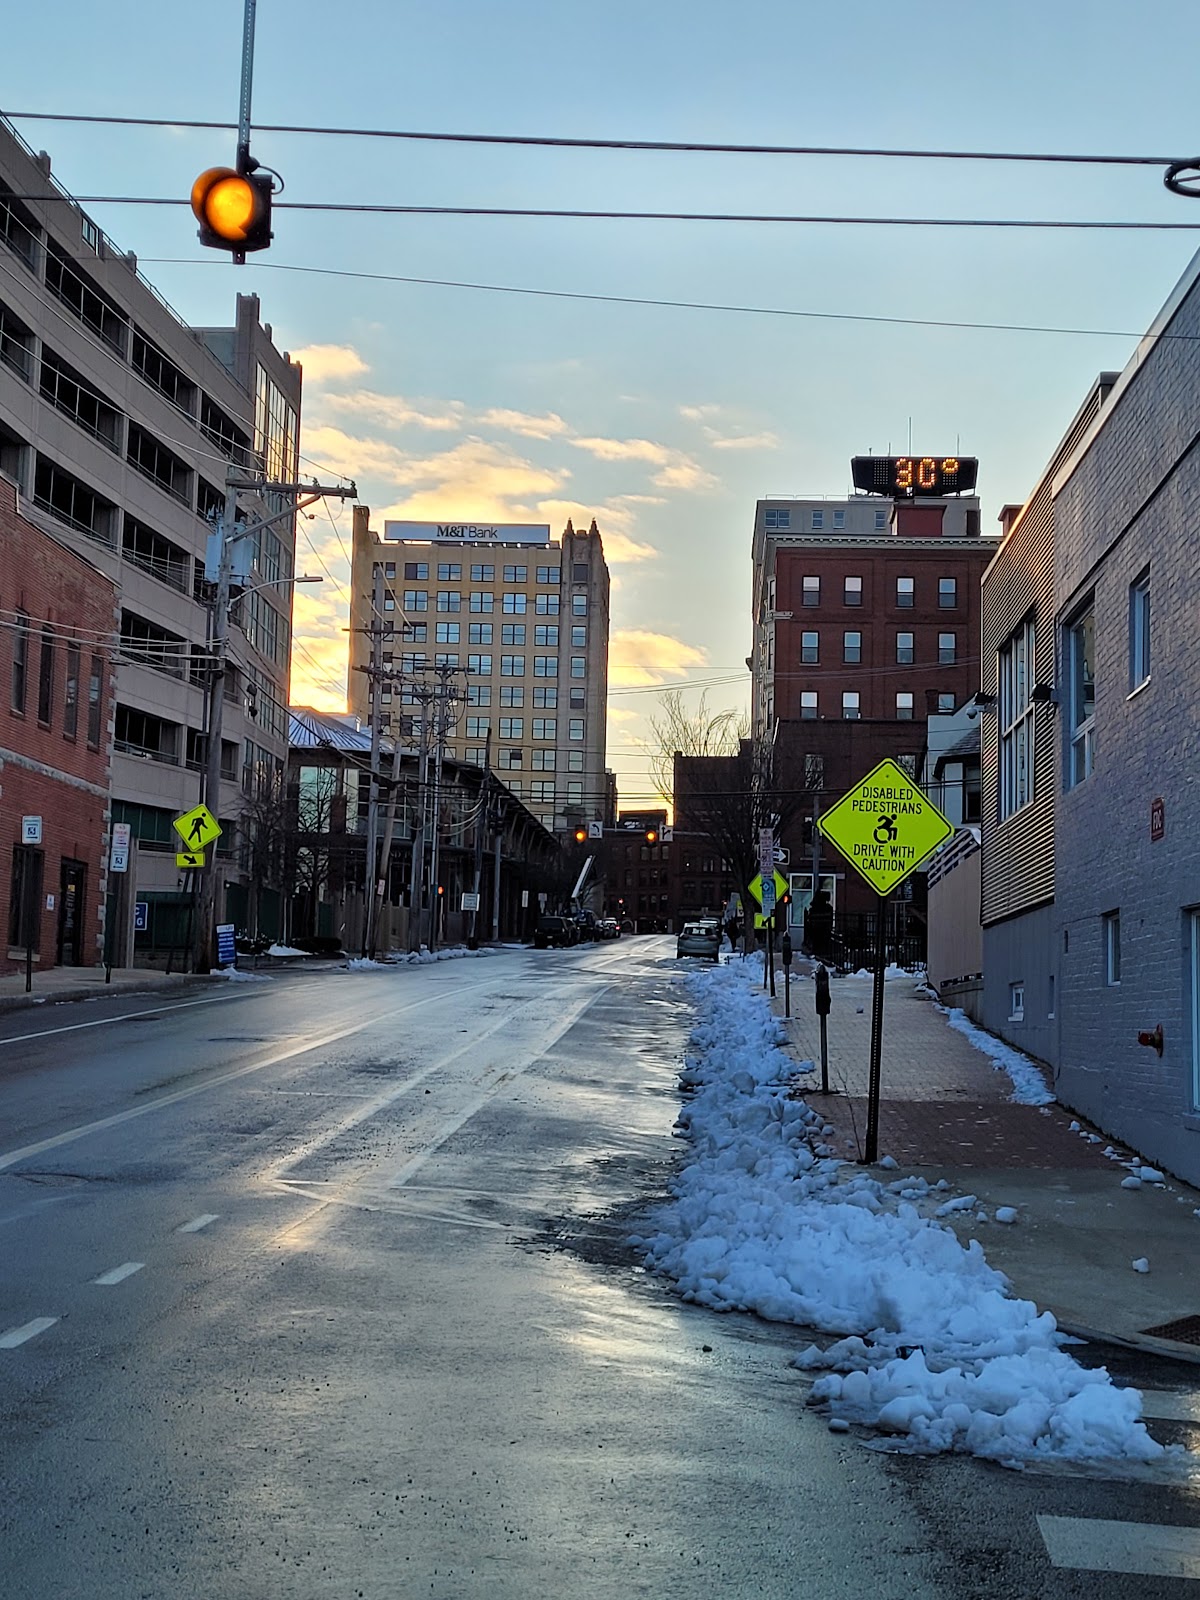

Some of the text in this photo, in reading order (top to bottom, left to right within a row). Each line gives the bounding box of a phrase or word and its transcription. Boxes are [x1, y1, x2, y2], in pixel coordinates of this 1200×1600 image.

[436, 525, 498, 539] M&T Bank
[862, 787, 914, 800] DISABLED
[852, 800, 922, 815] PEDESTRIANS
[853, 843, 915, 859] DRIVE WITH
[862, 858, 905, 872] CAUTION
